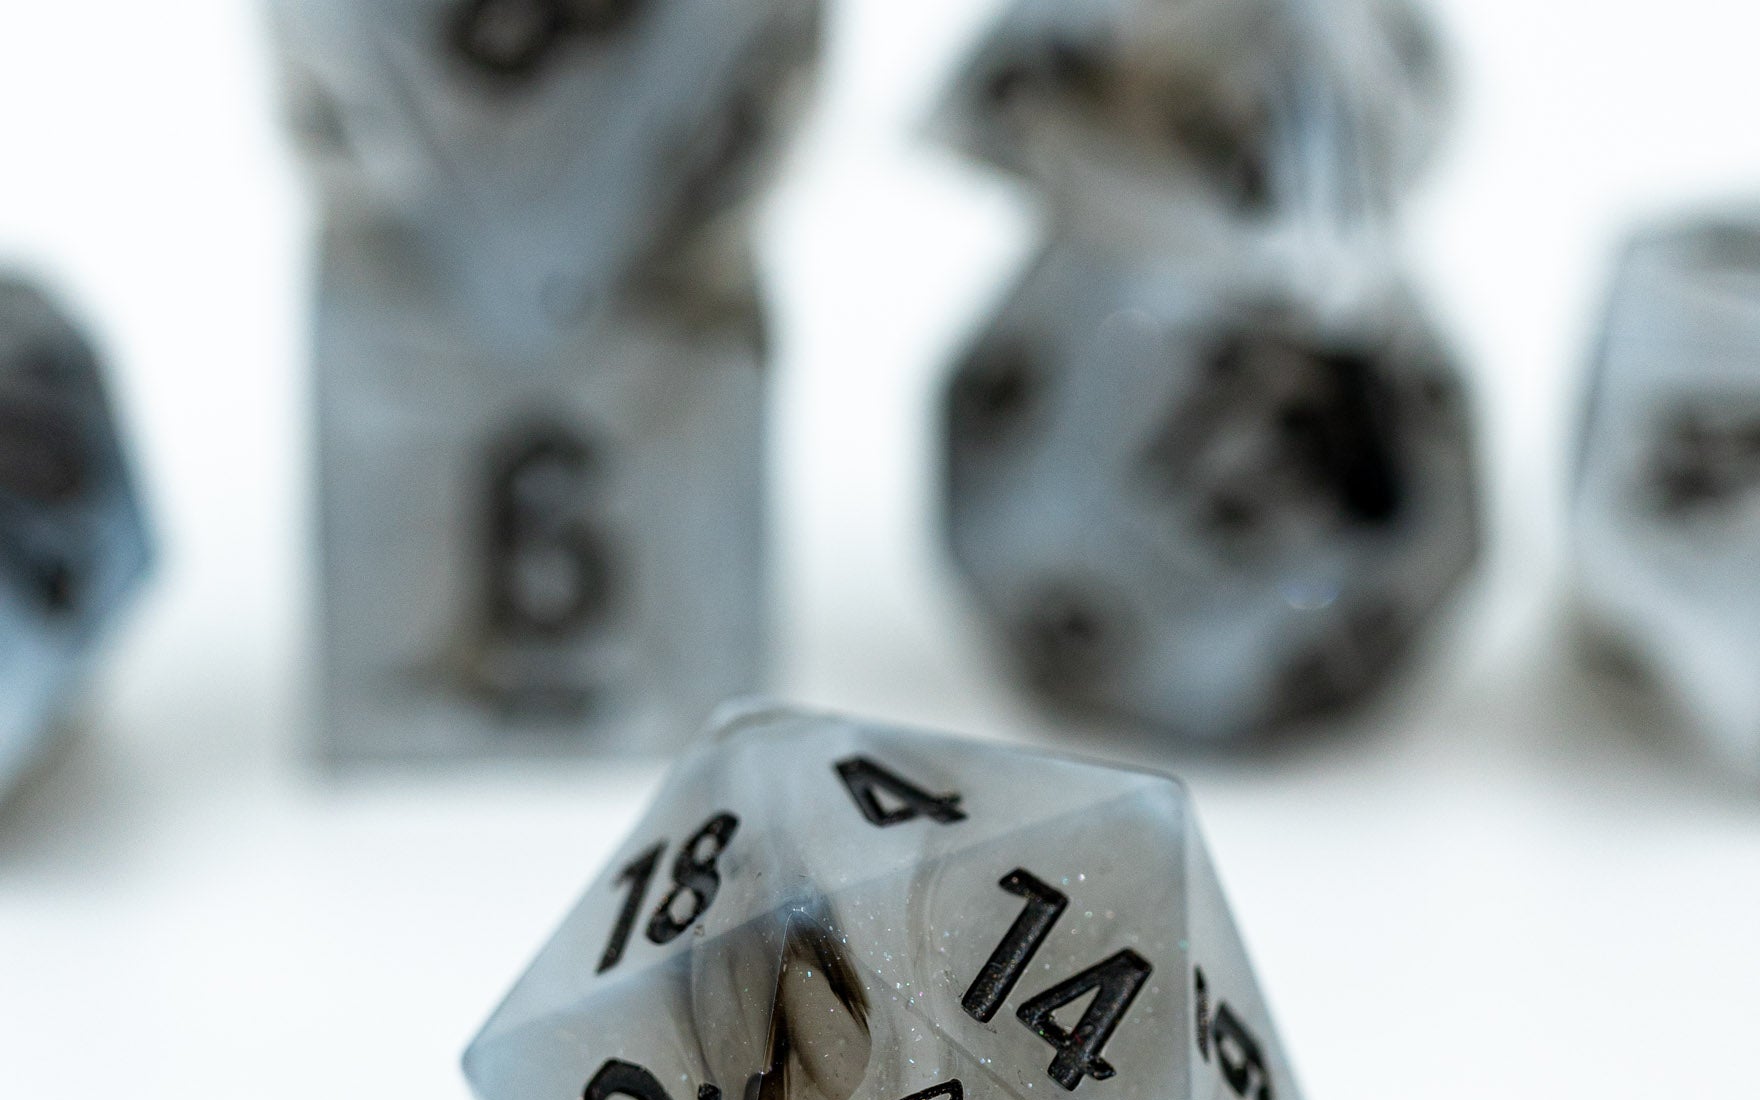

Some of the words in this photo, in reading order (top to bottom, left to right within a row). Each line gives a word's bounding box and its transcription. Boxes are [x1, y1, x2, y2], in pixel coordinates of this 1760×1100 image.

[834, 755, 968, 828] 4
[596, 811, 741, 974] 18
[960, 866, 1154, 1092] 14
